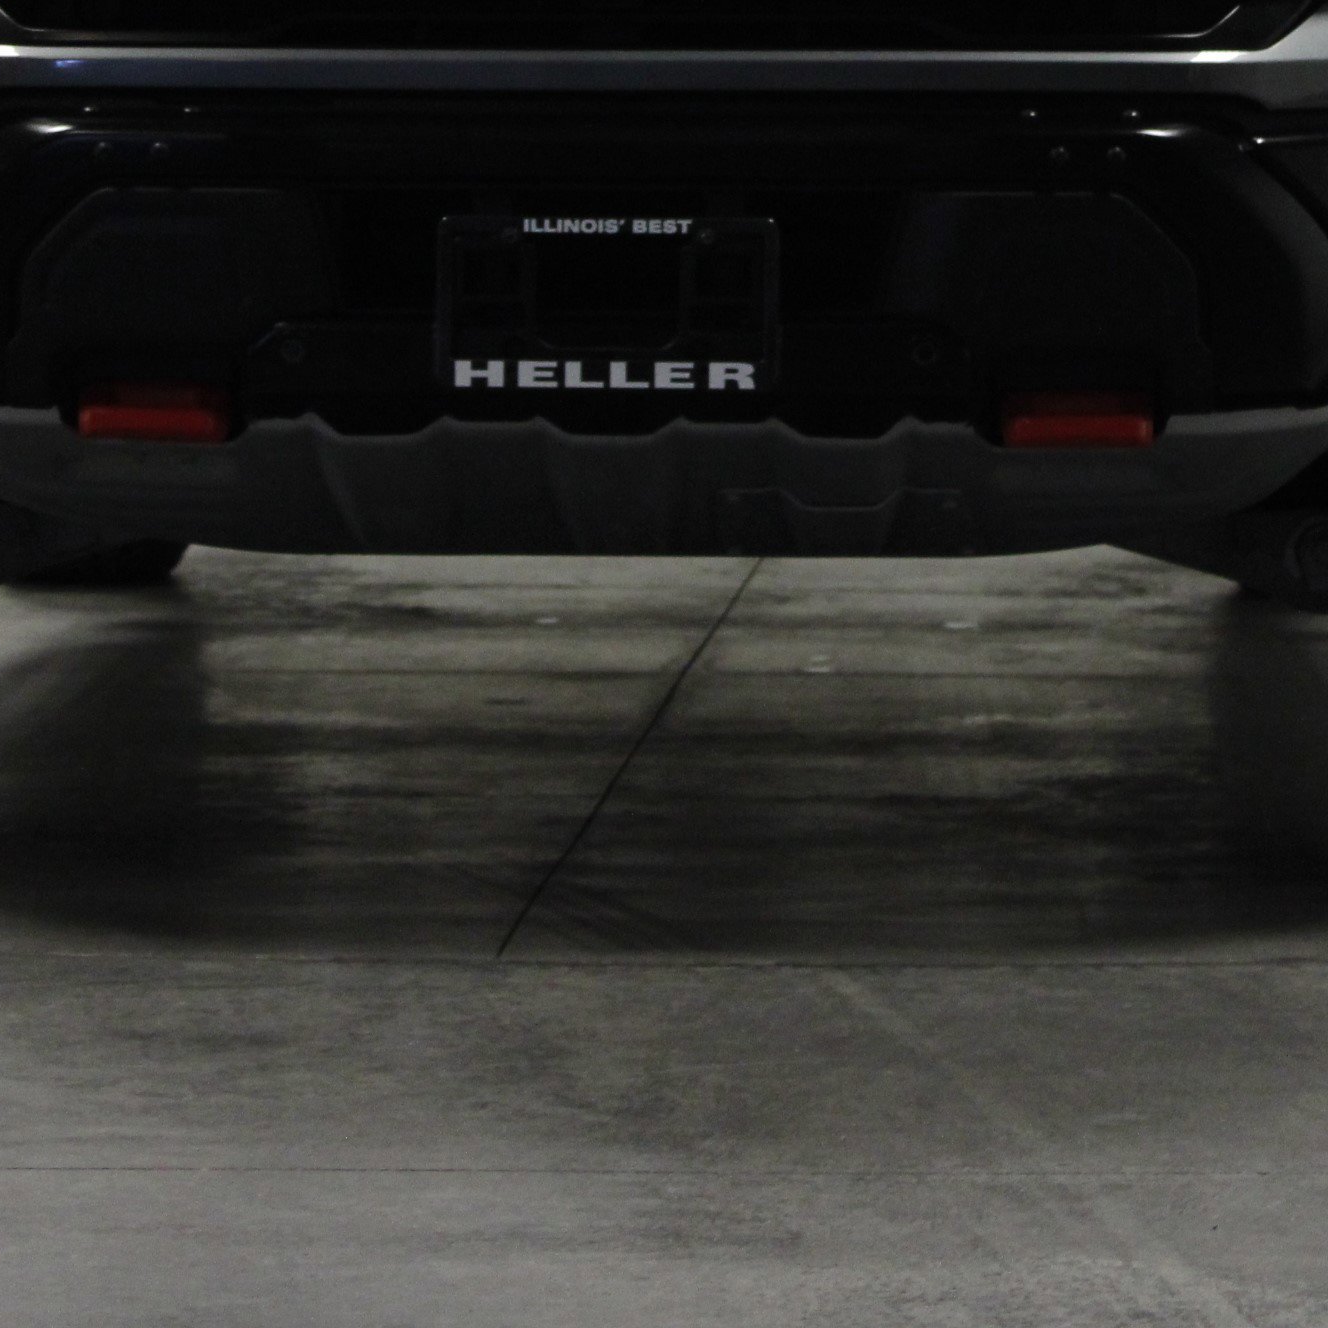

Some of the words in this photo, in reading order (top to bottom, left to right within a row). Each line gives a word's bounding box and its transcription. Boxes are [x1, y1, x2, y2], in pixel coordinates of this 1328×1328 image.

[522, 217, 626, 235] ILLINOIS'
[631, 218, 692, 235] BEST
[453, 359, 756, 390] HELLER
